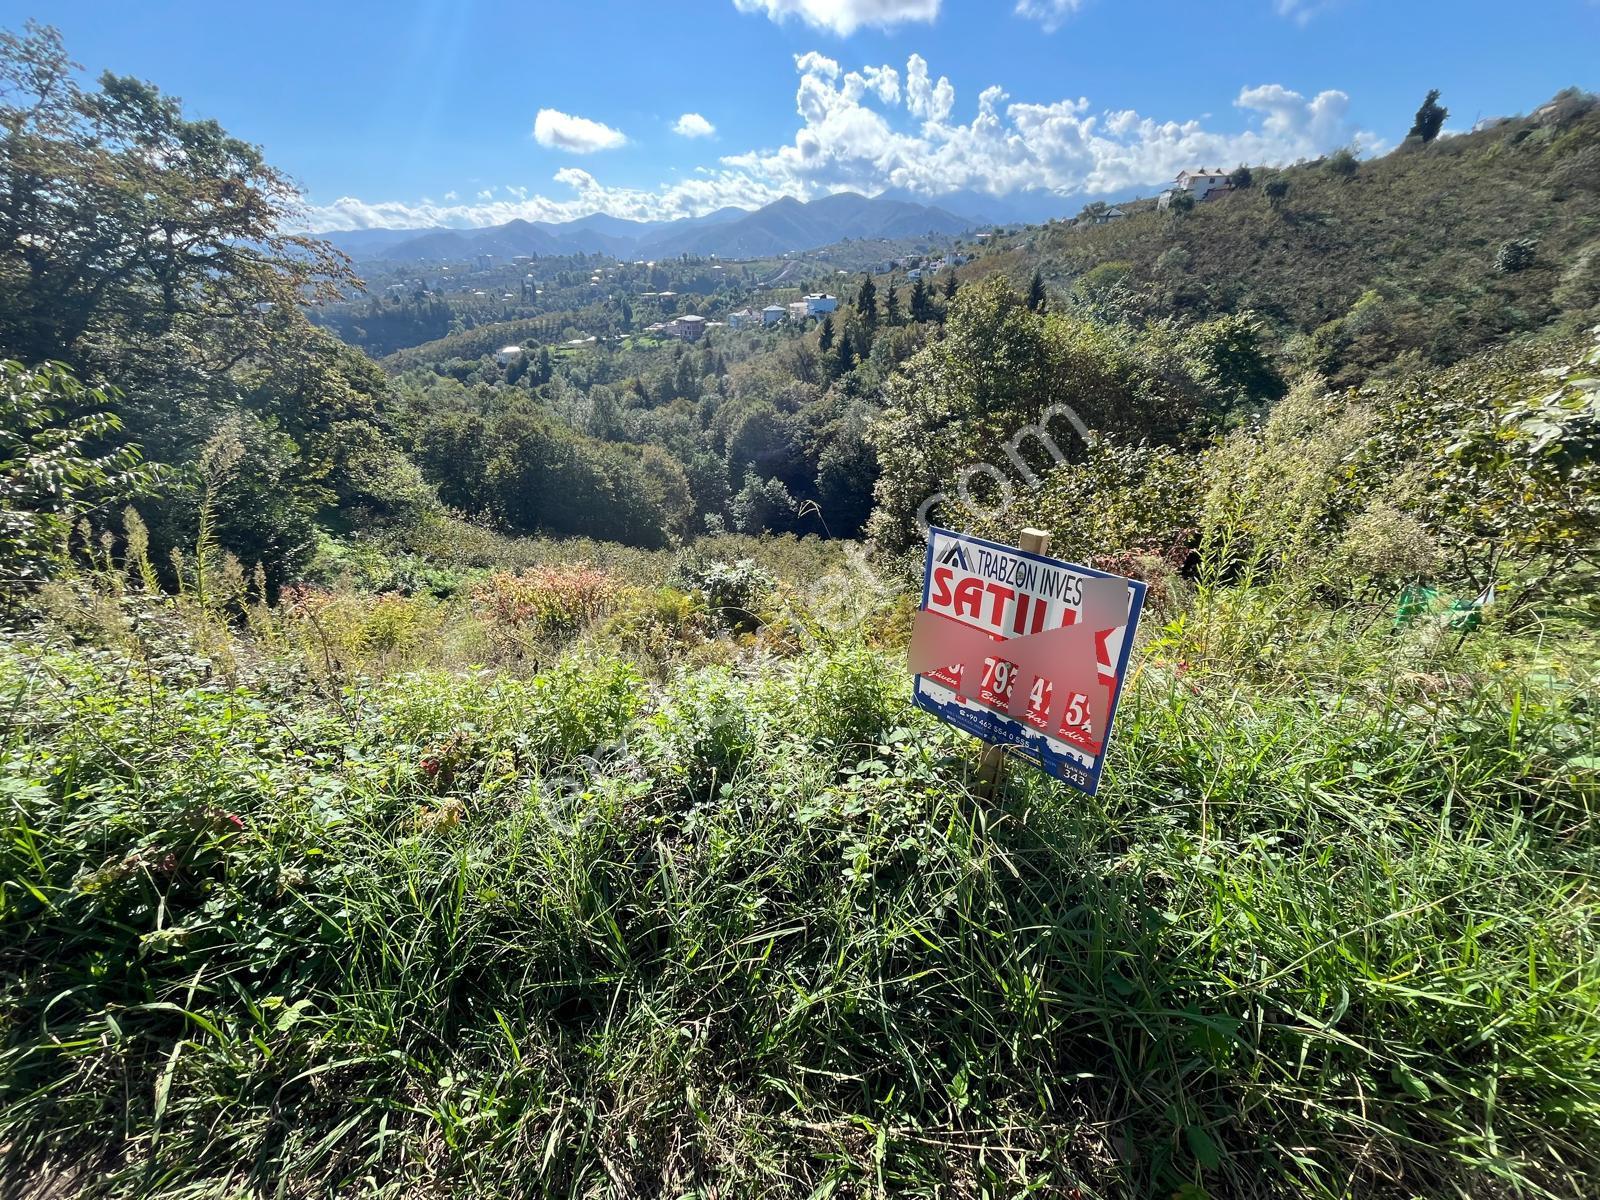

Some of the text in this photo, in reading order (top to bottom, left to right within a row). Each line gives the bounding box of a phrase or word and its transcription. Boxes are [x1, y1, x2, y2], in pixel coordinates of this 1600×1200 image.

[978, 549, 1083, 606] TRABZON INVES
[979, 718, 991, 730] 462
[993, 724, 1007, 737] 554
[1014, 737, 1030, 748] 555
[1063, 768, 1085, 785] 343
